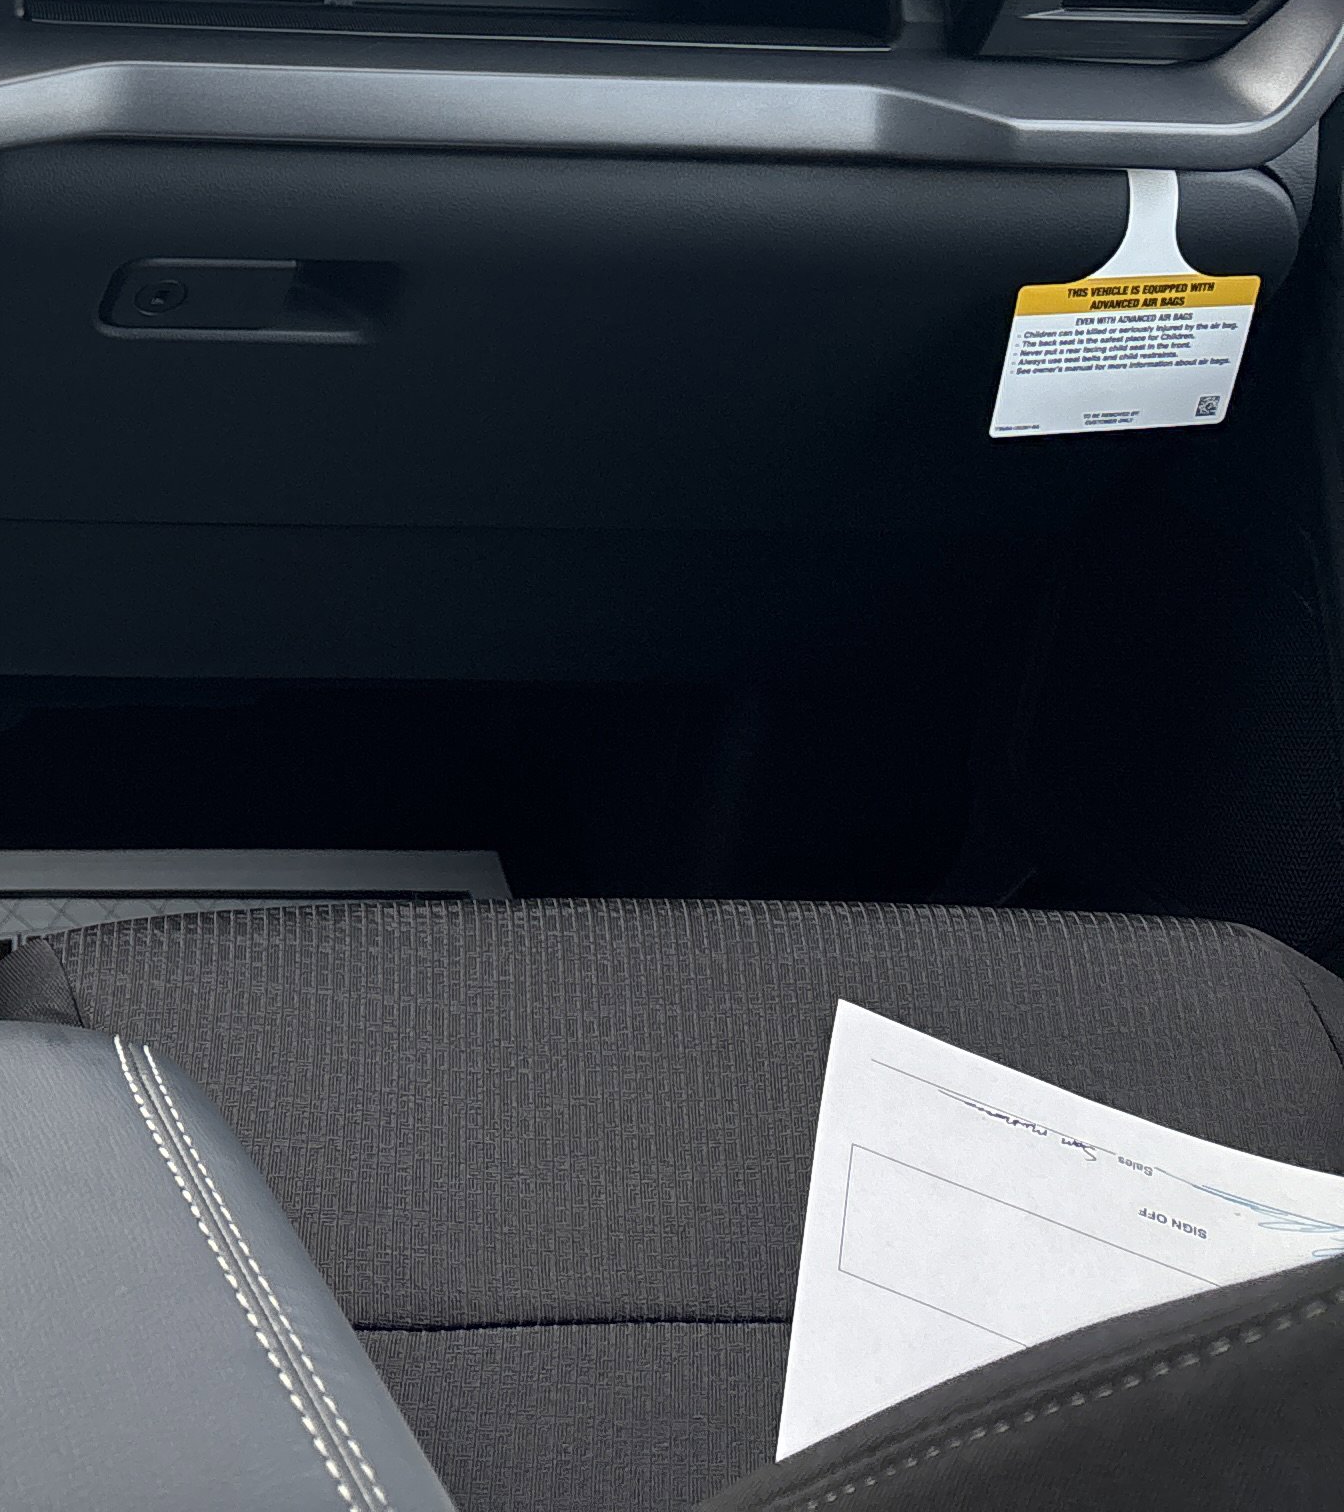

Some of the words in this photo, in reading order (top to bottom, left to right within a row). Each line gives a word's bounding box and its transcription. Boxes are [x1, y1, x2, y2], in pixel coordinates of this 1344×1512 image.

[1067, 287, 1088, 298] THIS
[1091, 286, 1129, 297] VEHICLE
[1131, 285, 1140, 295] IS
[1143, 283, 1188, 295] EQUIPPED
[1190, 282, 1215, 292] WITH
[1089, 299, 1140, 310] ADVANCED
[1142, 298, 1158, 308] AIR
[1160, 297, 1185, 307] BAGS
[1117, 314, 1157, 324] ADVANCED
[1173, 313, 1193, 321] BAGS
[1117, 1154, 1153, 1177] Sales
[1138, 1207, 1168, 1225] OFF
[1171, 1218, 1208, 1240] SIGN
